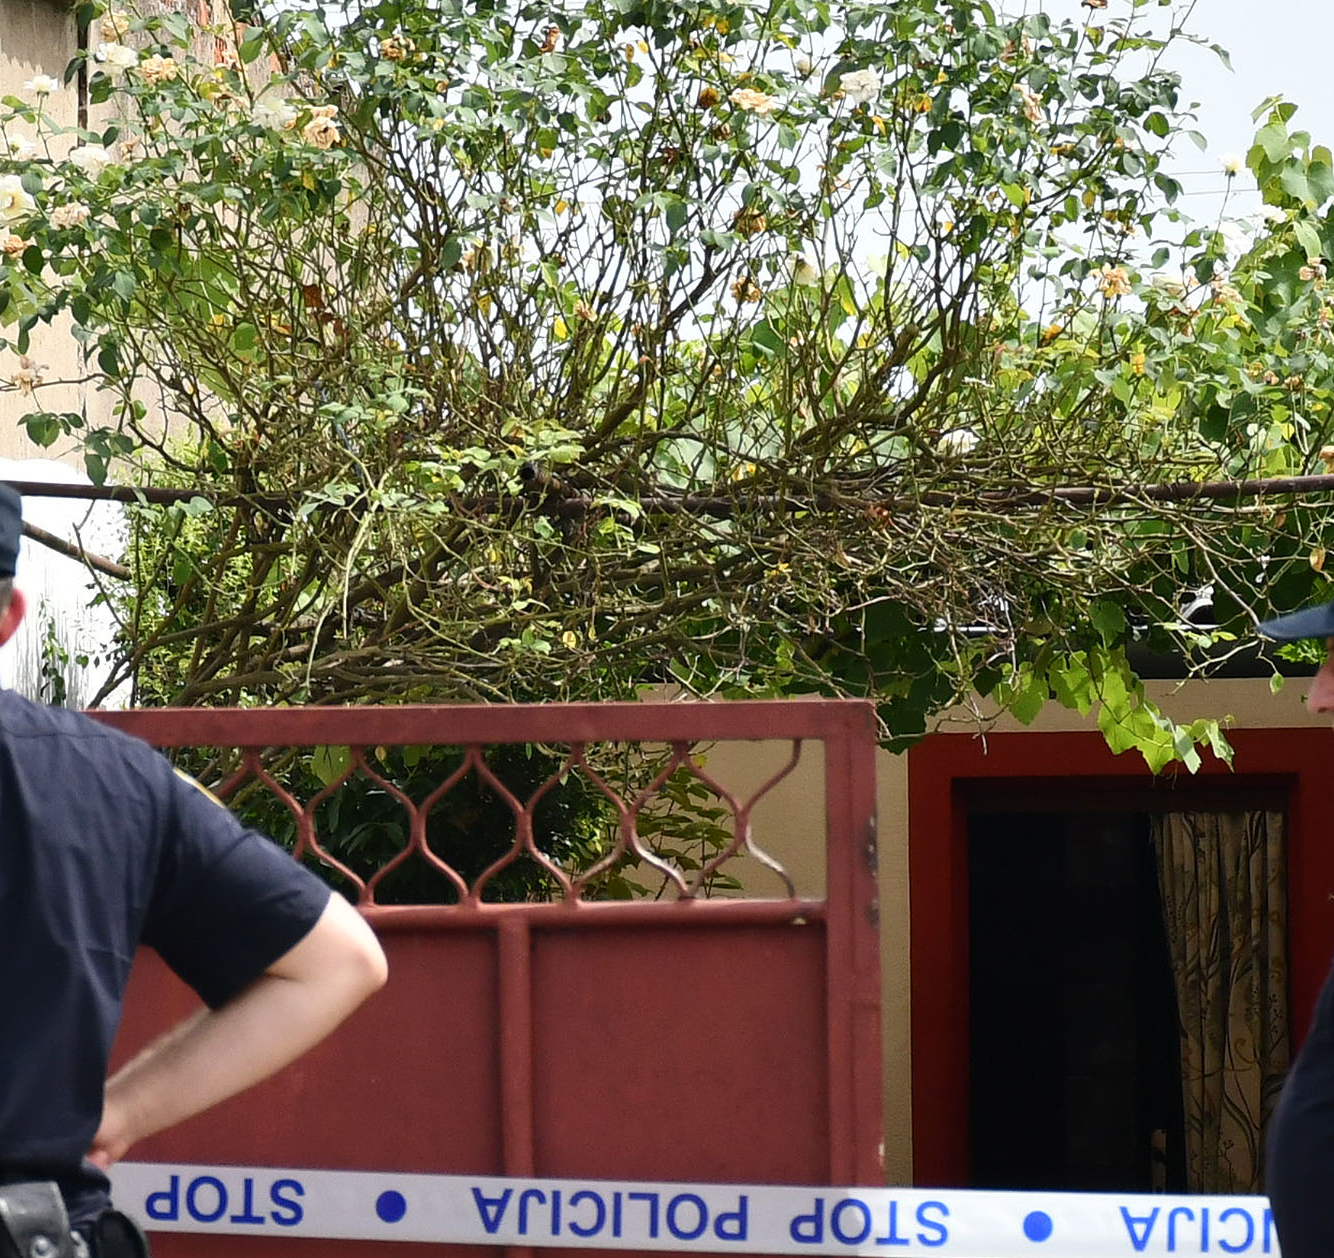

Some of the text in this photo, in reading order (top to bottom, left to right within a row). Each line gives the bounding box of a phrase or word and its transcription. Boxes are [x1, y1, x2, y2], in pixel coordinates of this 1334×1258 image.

[145, 1174, 306, 1227] STOP
[470, 1187, 950, 1248] STOP POLICIJA
